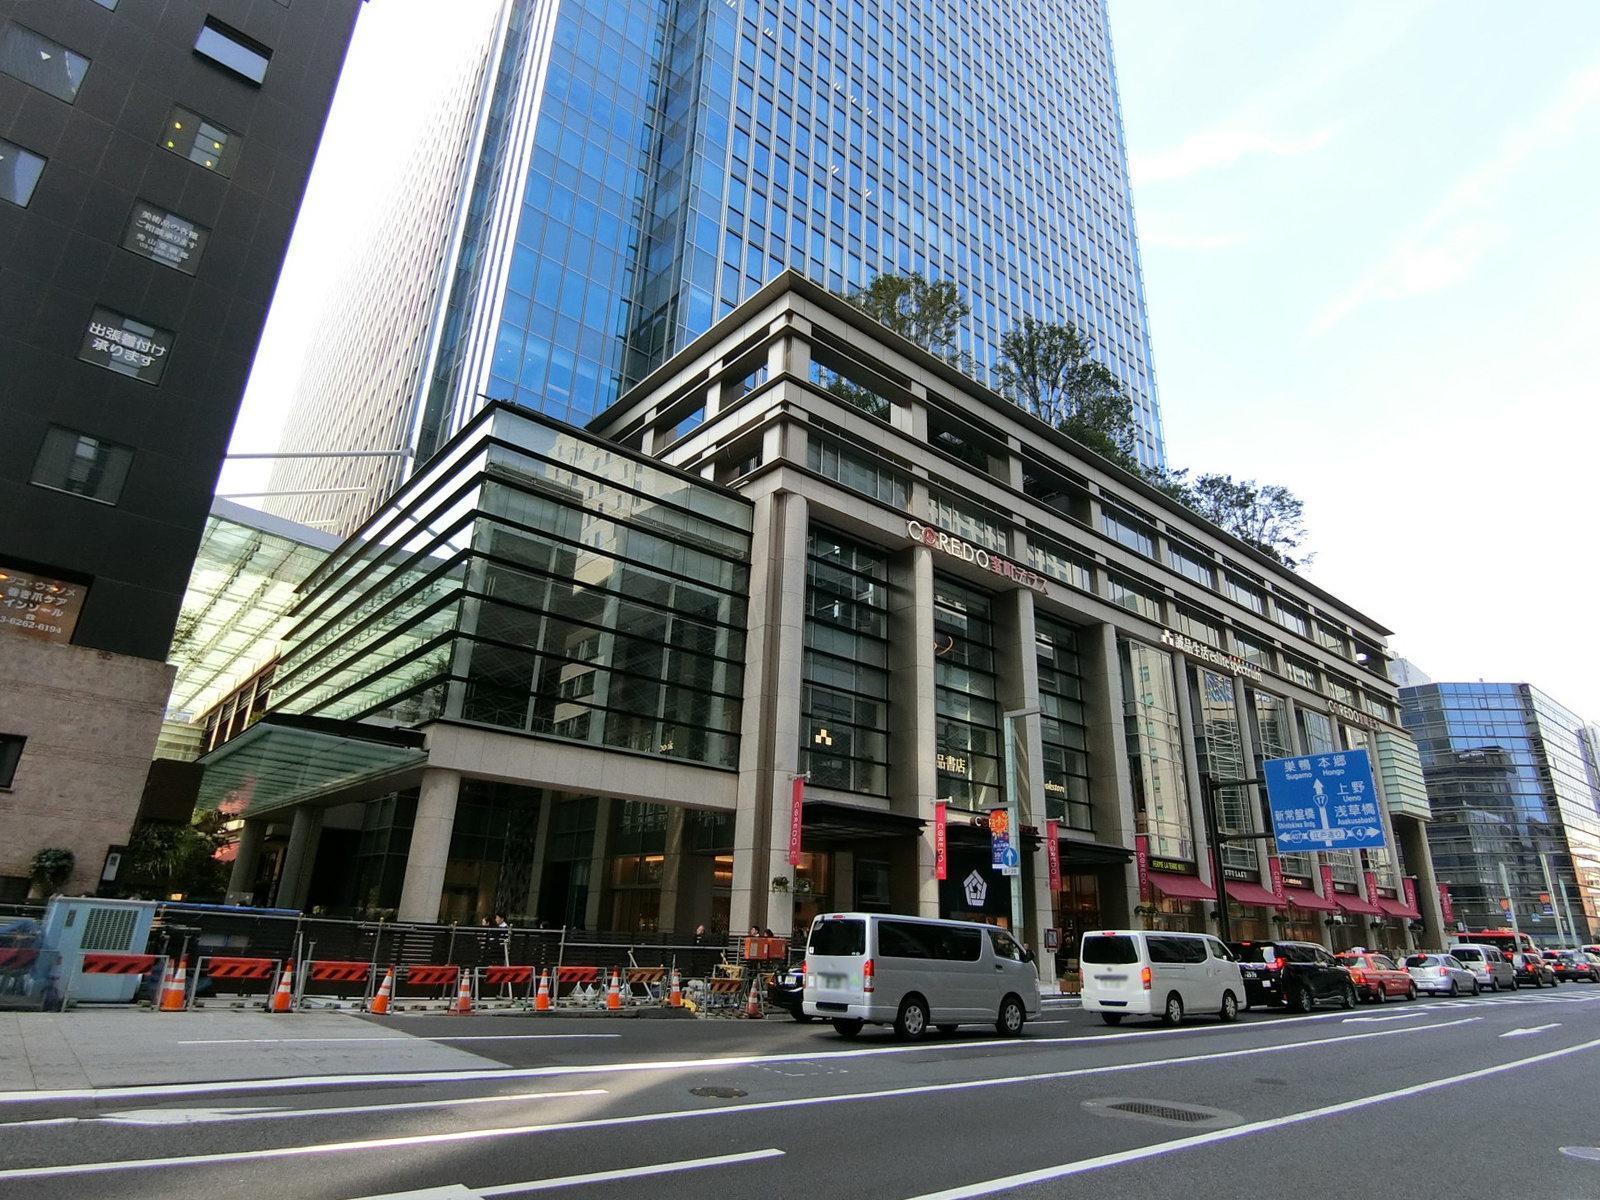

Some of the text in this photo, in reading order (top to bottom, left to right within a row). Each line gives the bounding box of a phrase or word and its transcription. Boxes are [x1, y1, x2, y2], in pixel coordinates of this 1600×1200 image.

[135, 219, 197, 249] ご相談承ります
[140, 210, 199, 240] 美術品の各種
[89, 322, 166, 357] 出張着付け
[92, 337, 155, 366] 承ります
[8, 587, 68, 606] 巻き爪ケア
[3, 599, 63, 617] インソール
[1284, 755, 1347, 773] 巣鴨 本郷
[1285, 772, 1312, 780] Sugamo
[1337, 780, 1365, 795] 上野
[1316, 796, 1325, 804] 17
[1274, 807, 1315, 821] 新常盤橋
[1334, 802, 1376, 818] 浅草橋
[792, 801, 800, 846] COREDO
[1313, 830, 1342, 839] 江戸通り
[1139, 852, 1147, 885] COREDO
